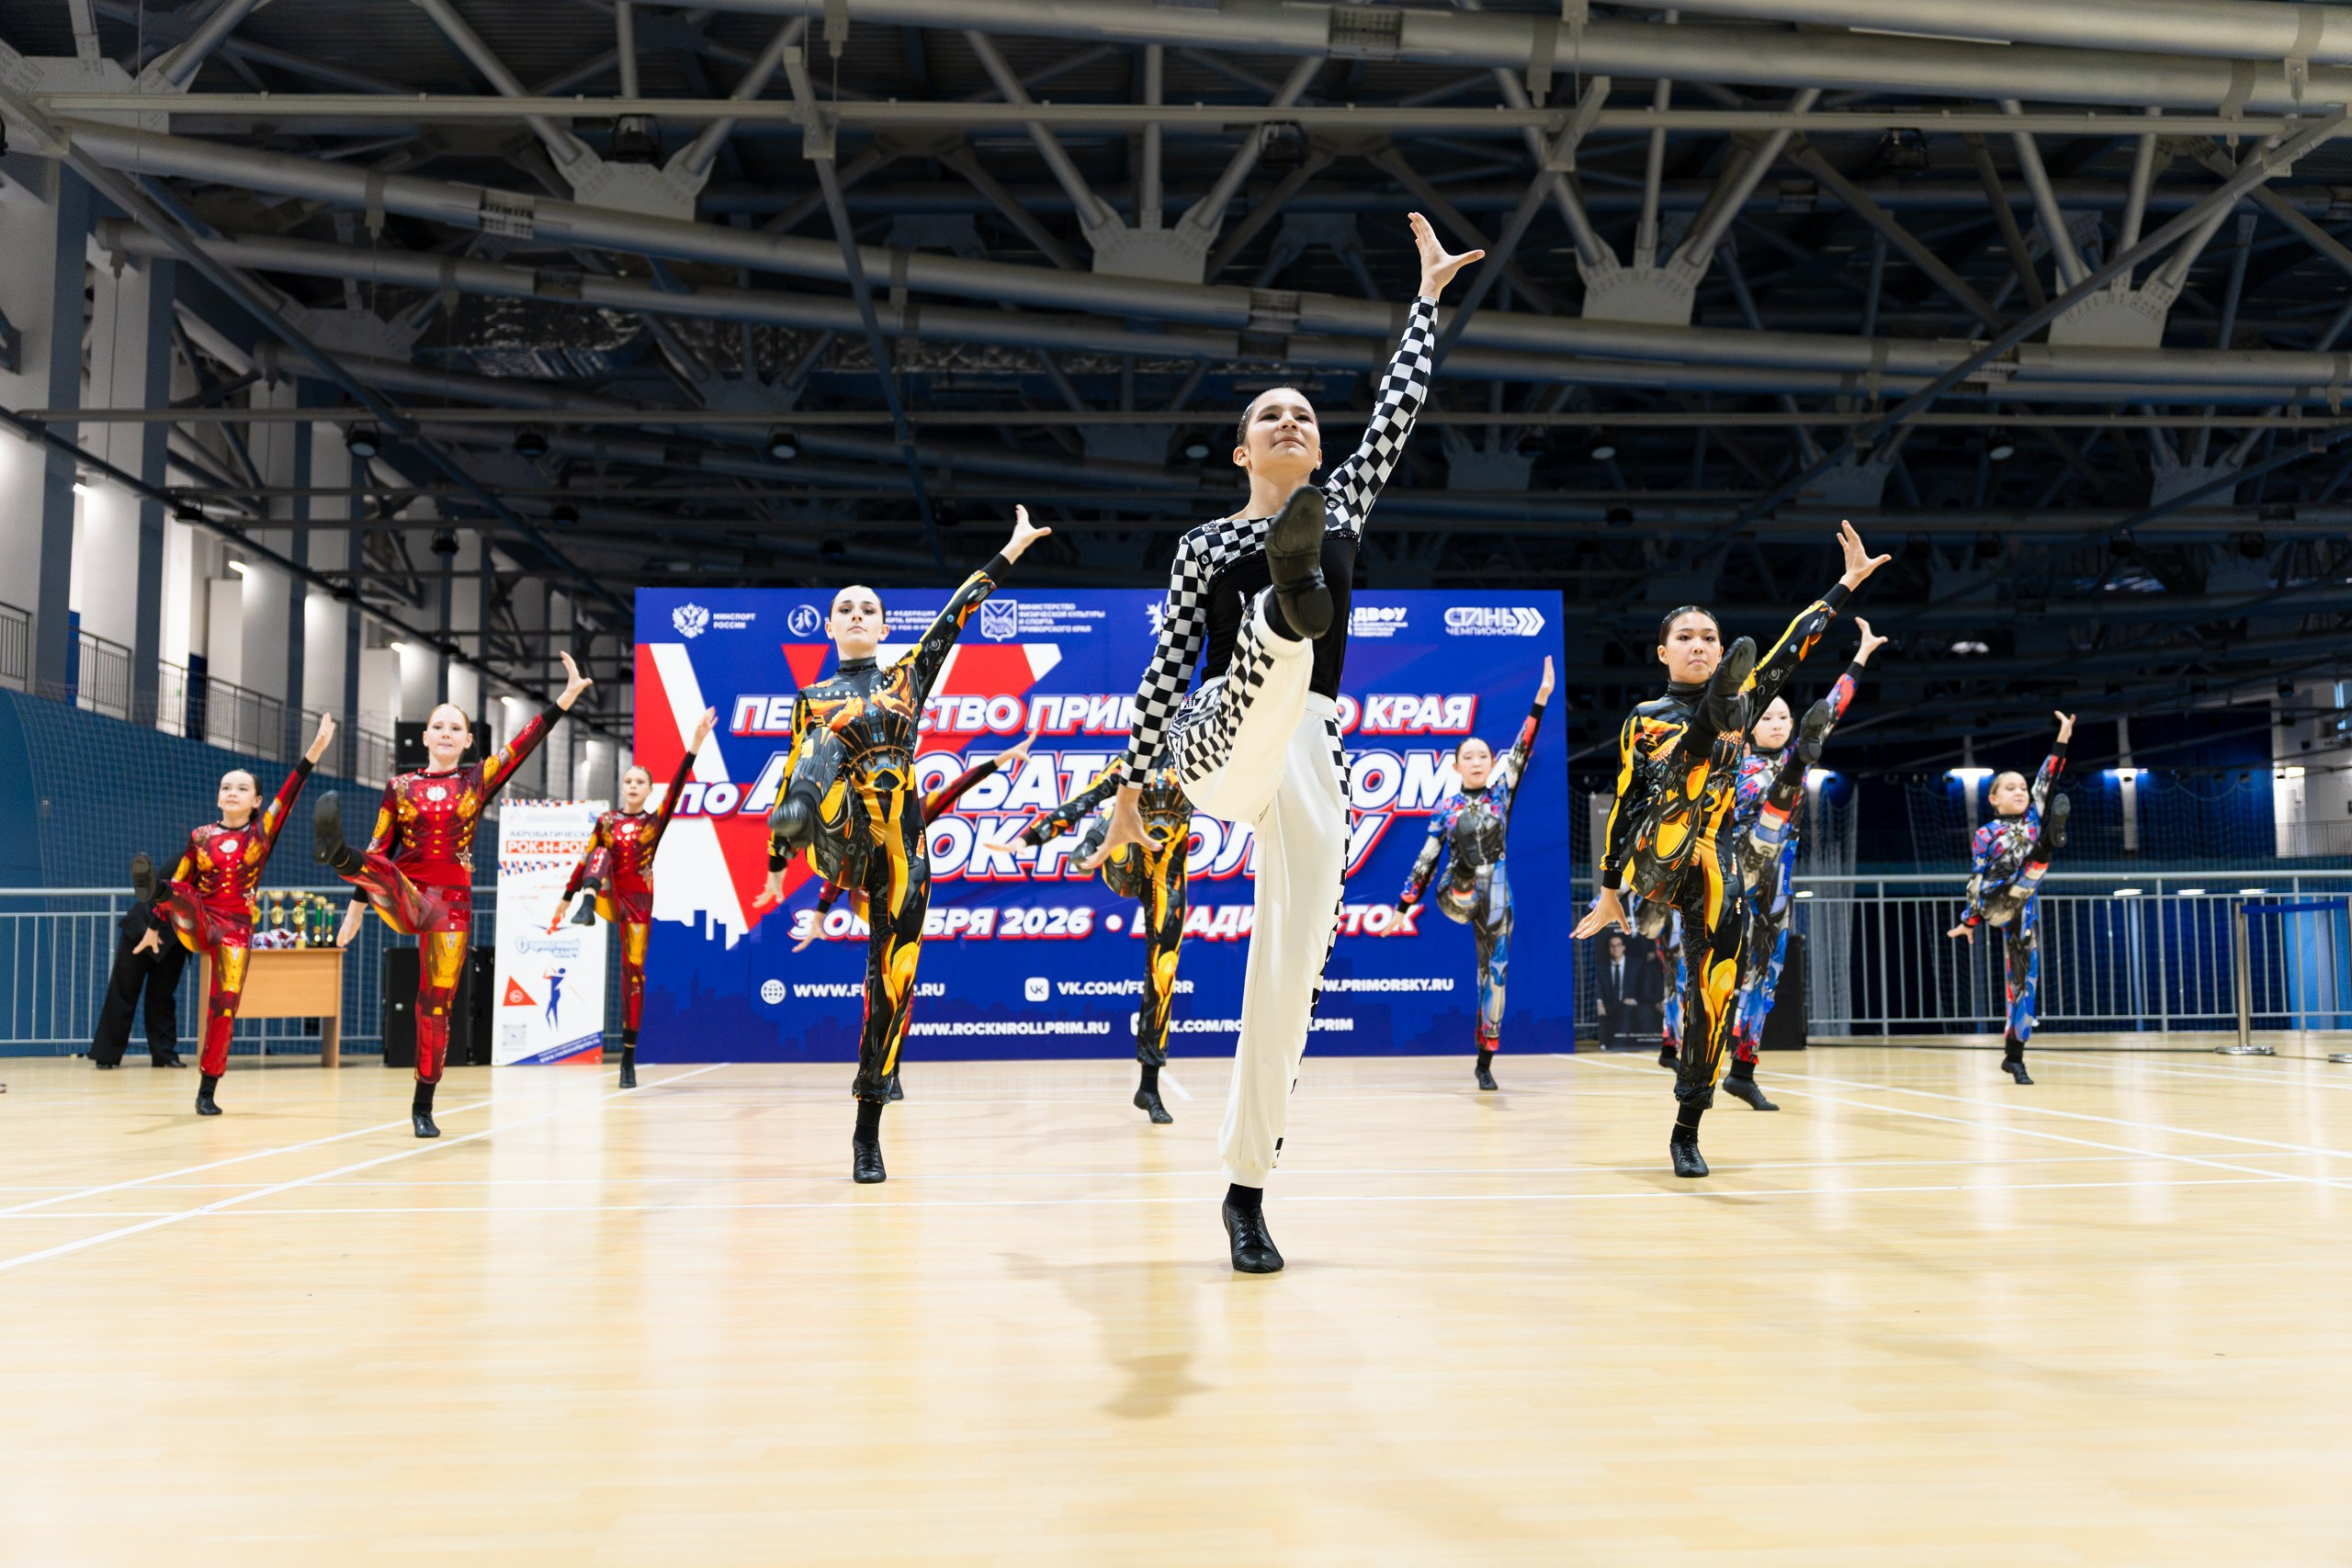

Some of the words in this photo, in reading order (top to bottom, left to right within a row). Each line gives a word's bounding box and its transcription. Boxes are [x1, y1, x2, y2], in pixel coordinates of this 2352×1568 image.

[713, 613, 756, 621] МИНСПОРТ
[1352, 607, 1408, 623] ДВФУ
[1444, 607, 1517, 626] СТАНЬ
[713, 621, 747, 629] РОССИИ
[1445, 626, 1517, 636] ЧЕМПИОНОМ
[1362, 694, 1476, 734] КРАЯ
[788, 908, 818, 940] 3
[999, 908, 1094, 939] 2026
[908, 1021, 1111, 1036] WWW.ROCKNROLLPRIM.RU
